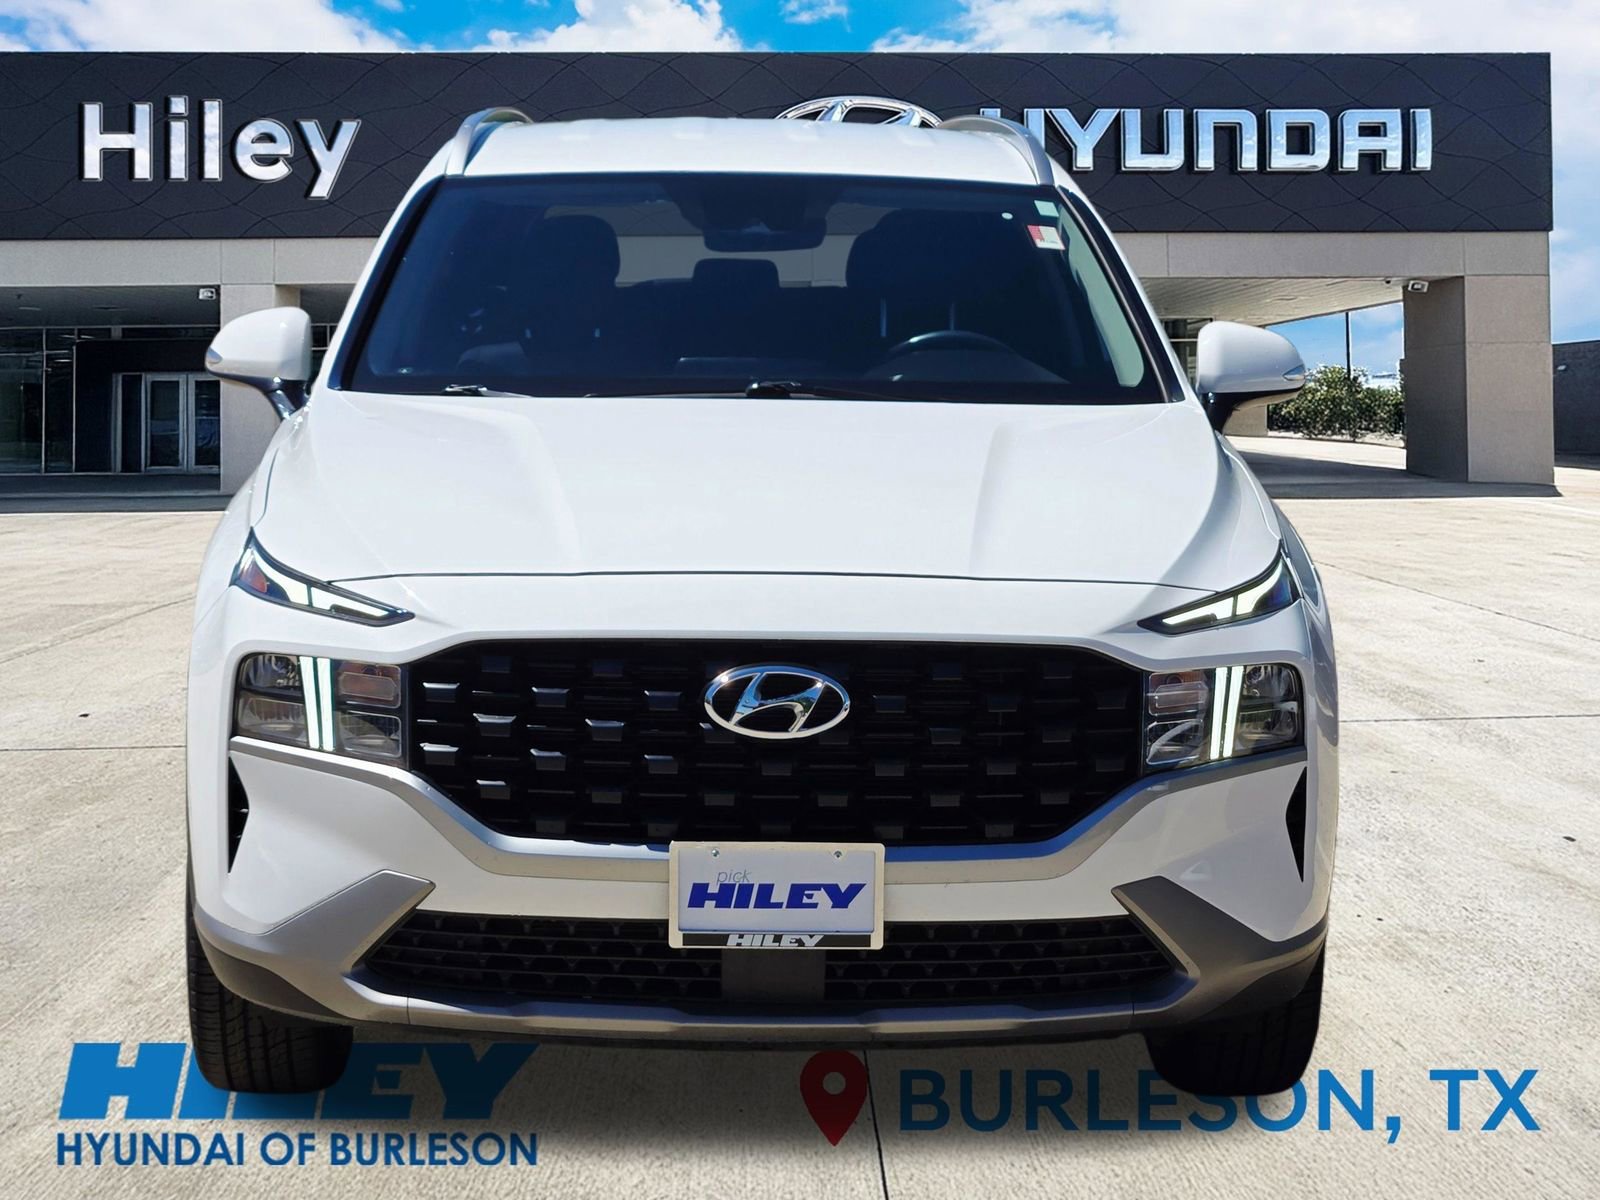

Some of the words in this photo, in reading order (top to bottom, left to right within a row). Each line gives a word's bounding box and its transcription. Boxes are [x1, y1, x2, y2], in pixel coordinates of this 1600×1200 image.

[80, 96, 362, 200] Hiley
[715, 868, 752, 886] pick
[687, 882, 867, 910] HILEY
[726, 933, 825, 948] HILEY
